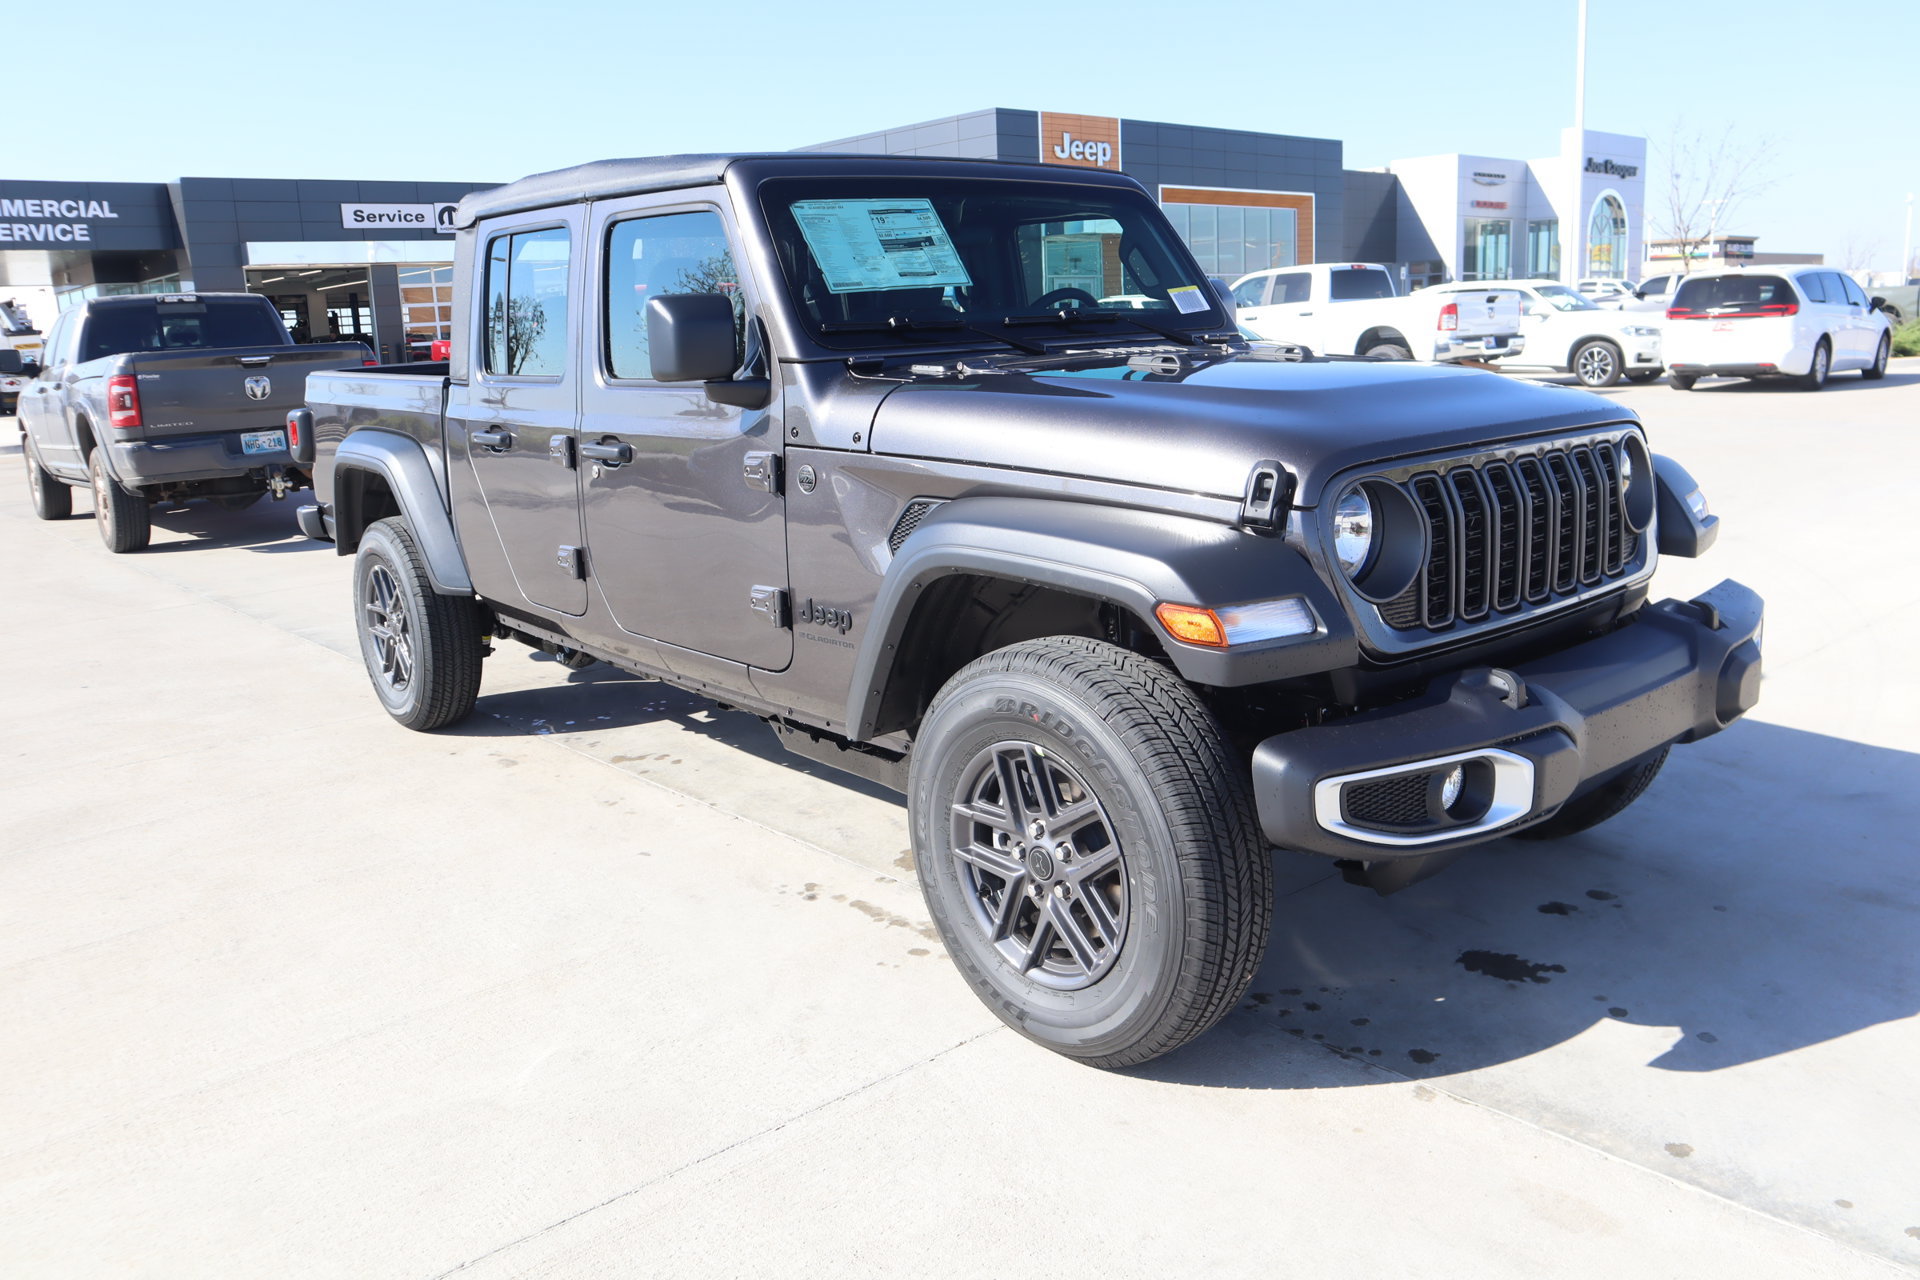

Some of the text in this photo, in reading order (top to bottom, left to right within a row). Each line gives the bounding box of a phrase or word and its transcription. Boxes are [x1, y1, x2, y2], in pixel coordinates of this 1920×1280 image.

[1053, 131, 1112, 167] Jeep
[0, 199, 119, 218] MERCIAL
[353, 209, 425, 223] Service
[875, 216, 886, 224] 19
[150, 420, 194, 429] LIMITED
[800, 597, 853, 635] Jeep
[806, 633, 855, 649] GLADIATOR
[993, 698, 1160, 934] BRIDGESTONE
